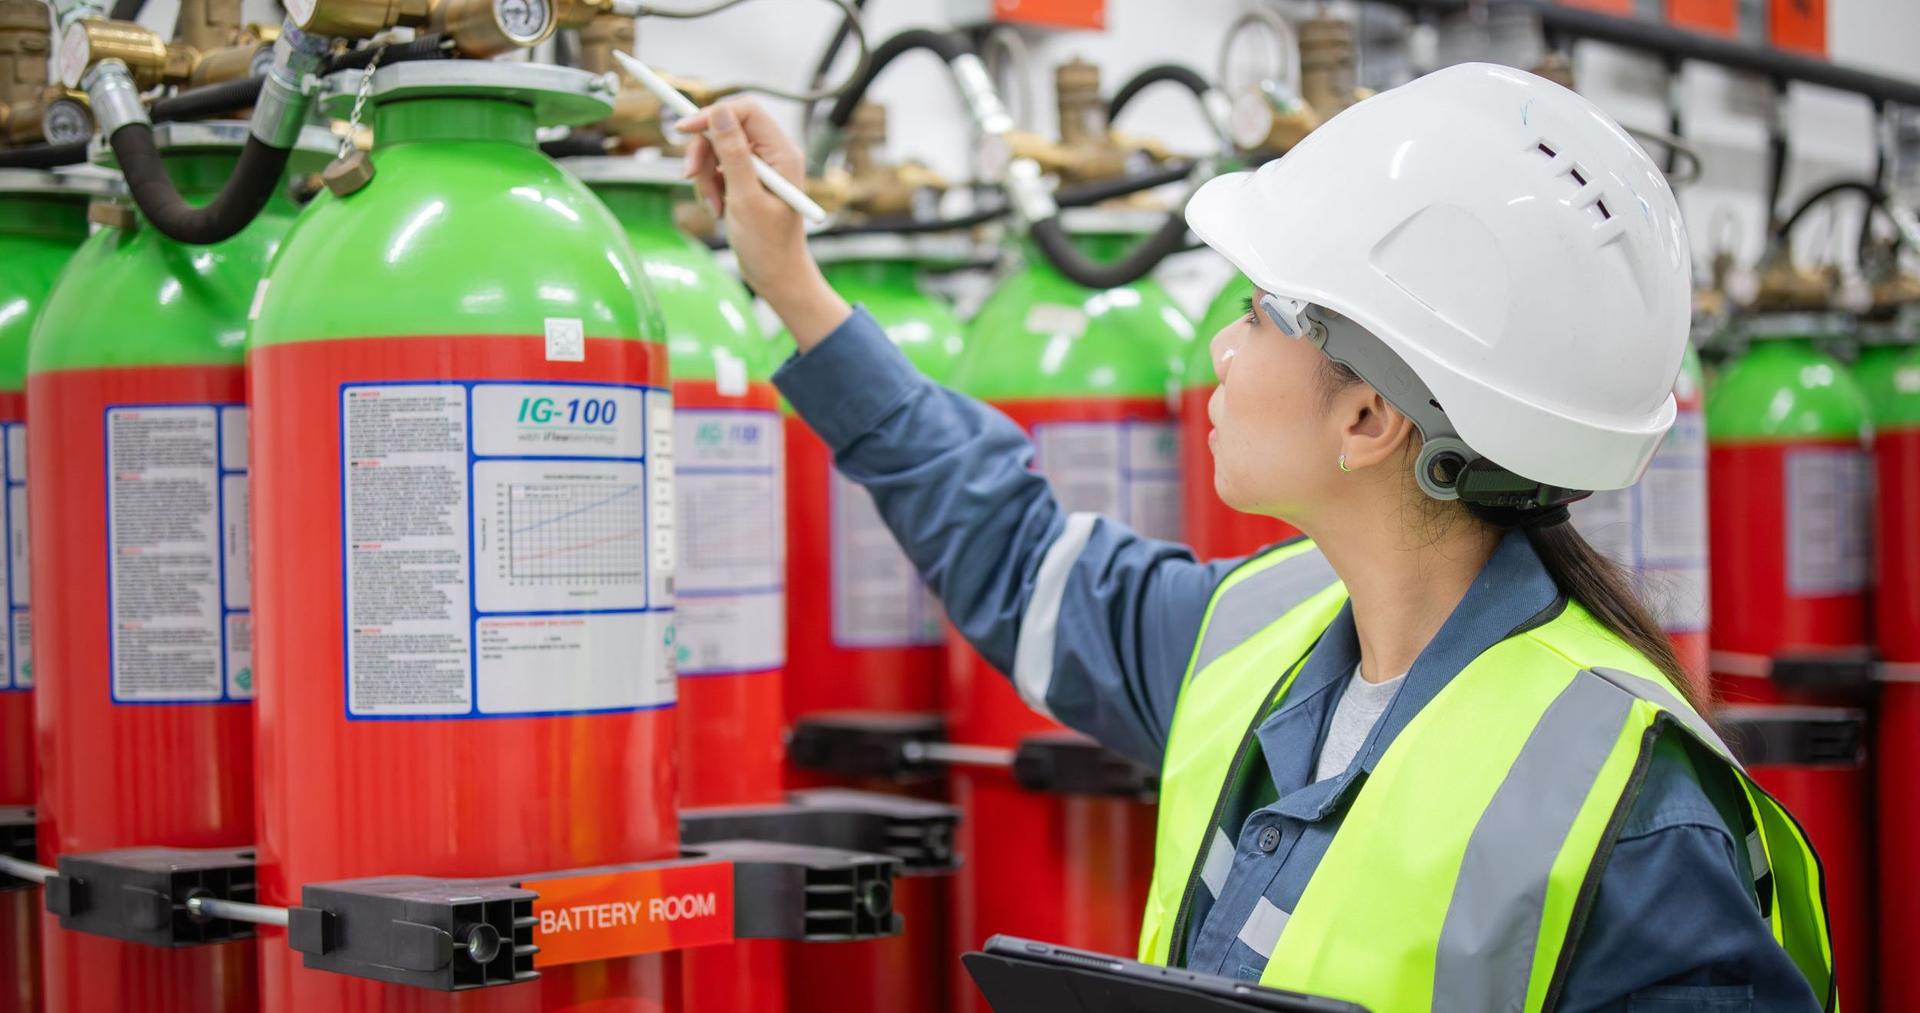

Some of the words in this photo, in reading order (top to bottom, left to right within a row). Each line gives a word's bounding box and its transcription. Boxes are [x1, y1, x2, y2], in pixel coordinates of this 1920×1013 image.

[517, 398, 617, 425] IG-100
[540, 901, 641, 934] BATTERY
[649, 892, 716, 922] ROOM
